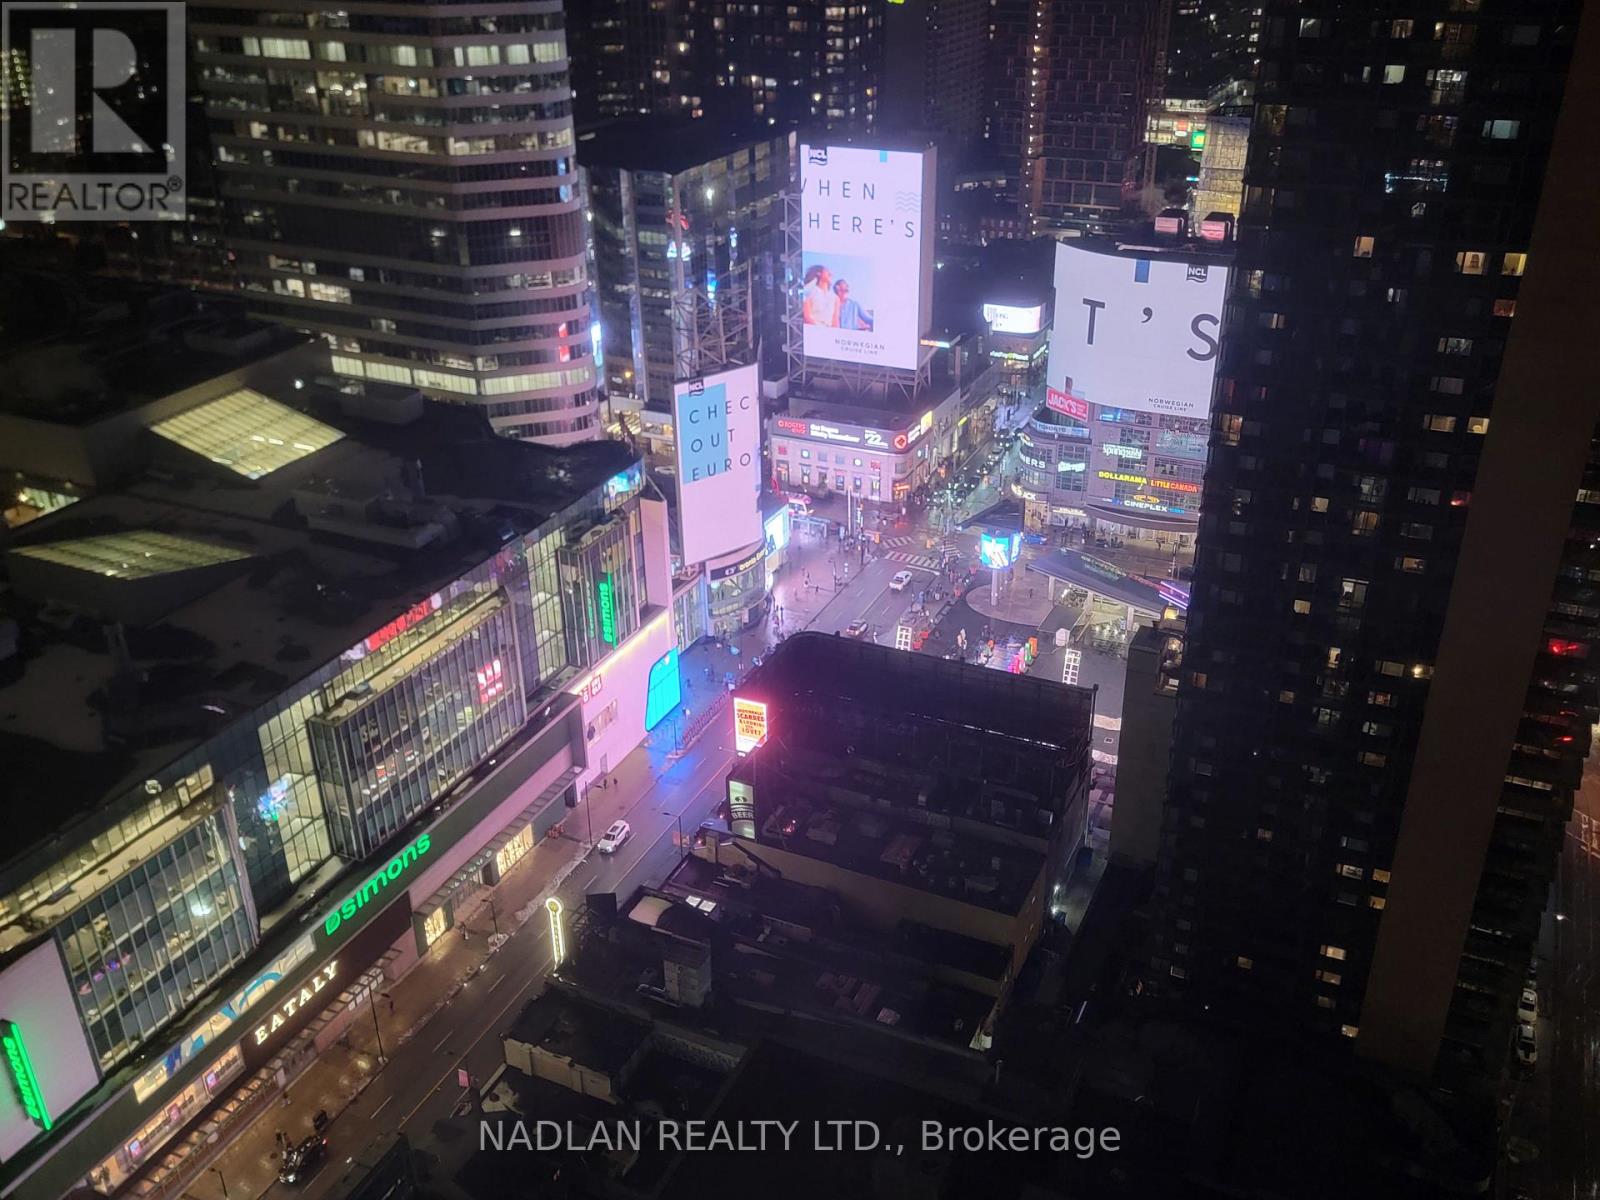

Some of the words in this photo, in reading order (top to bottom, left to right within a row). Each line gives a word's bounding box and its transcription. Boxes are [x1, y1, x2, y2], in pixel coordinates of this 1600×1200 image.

[809, 212, 915, 238] HERE'S
[1188, 266, 1207, 277] NCL
[834, 338, 885, 351] NORWEGIAN
[689, 396, 750, 424] CHEC
[1049, 392, 1077, 413] JACK'S
[1148, 398, 1194, 408] NORWEGIAN
[691, 429, 736, 453] OUT
[692, 453, 751, 481] EURO
[1098, 471, 1148, 484] DOLLARAMA
[1151, 479, 1170, 489] LITTLE
[1170, 482, 1198, 493] CANADA
[1124, 500, 1168, 512] CINEPLEX
[342, 833, 431, 921] simons
[254, 960, 340, 1045] EATALY
